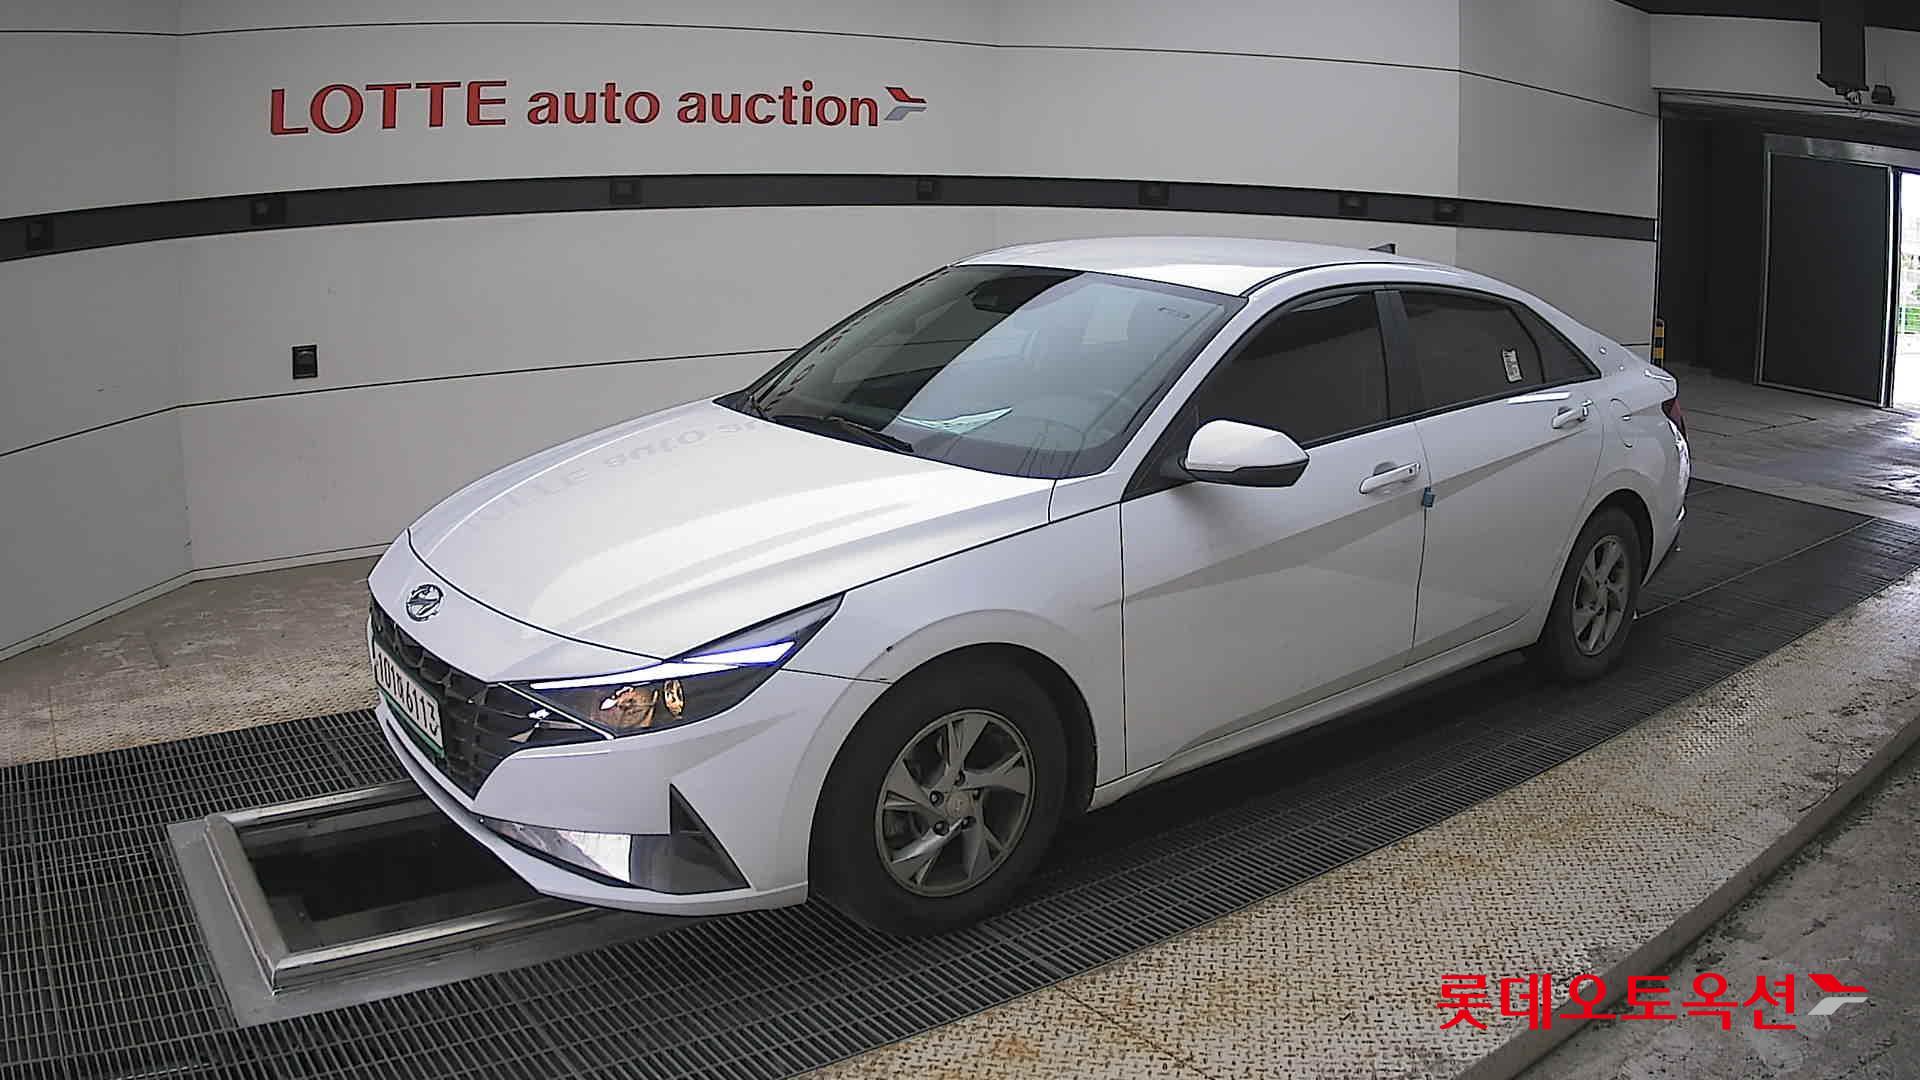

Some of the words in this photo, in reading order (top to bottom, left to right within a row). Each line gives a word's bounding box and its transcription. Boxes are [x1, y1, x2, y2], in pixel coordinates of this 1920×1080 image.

[270, 80, 508, 136] LOTTE
[527, 82, 661, 126] auto
[676, 80, 879, 127] auction
